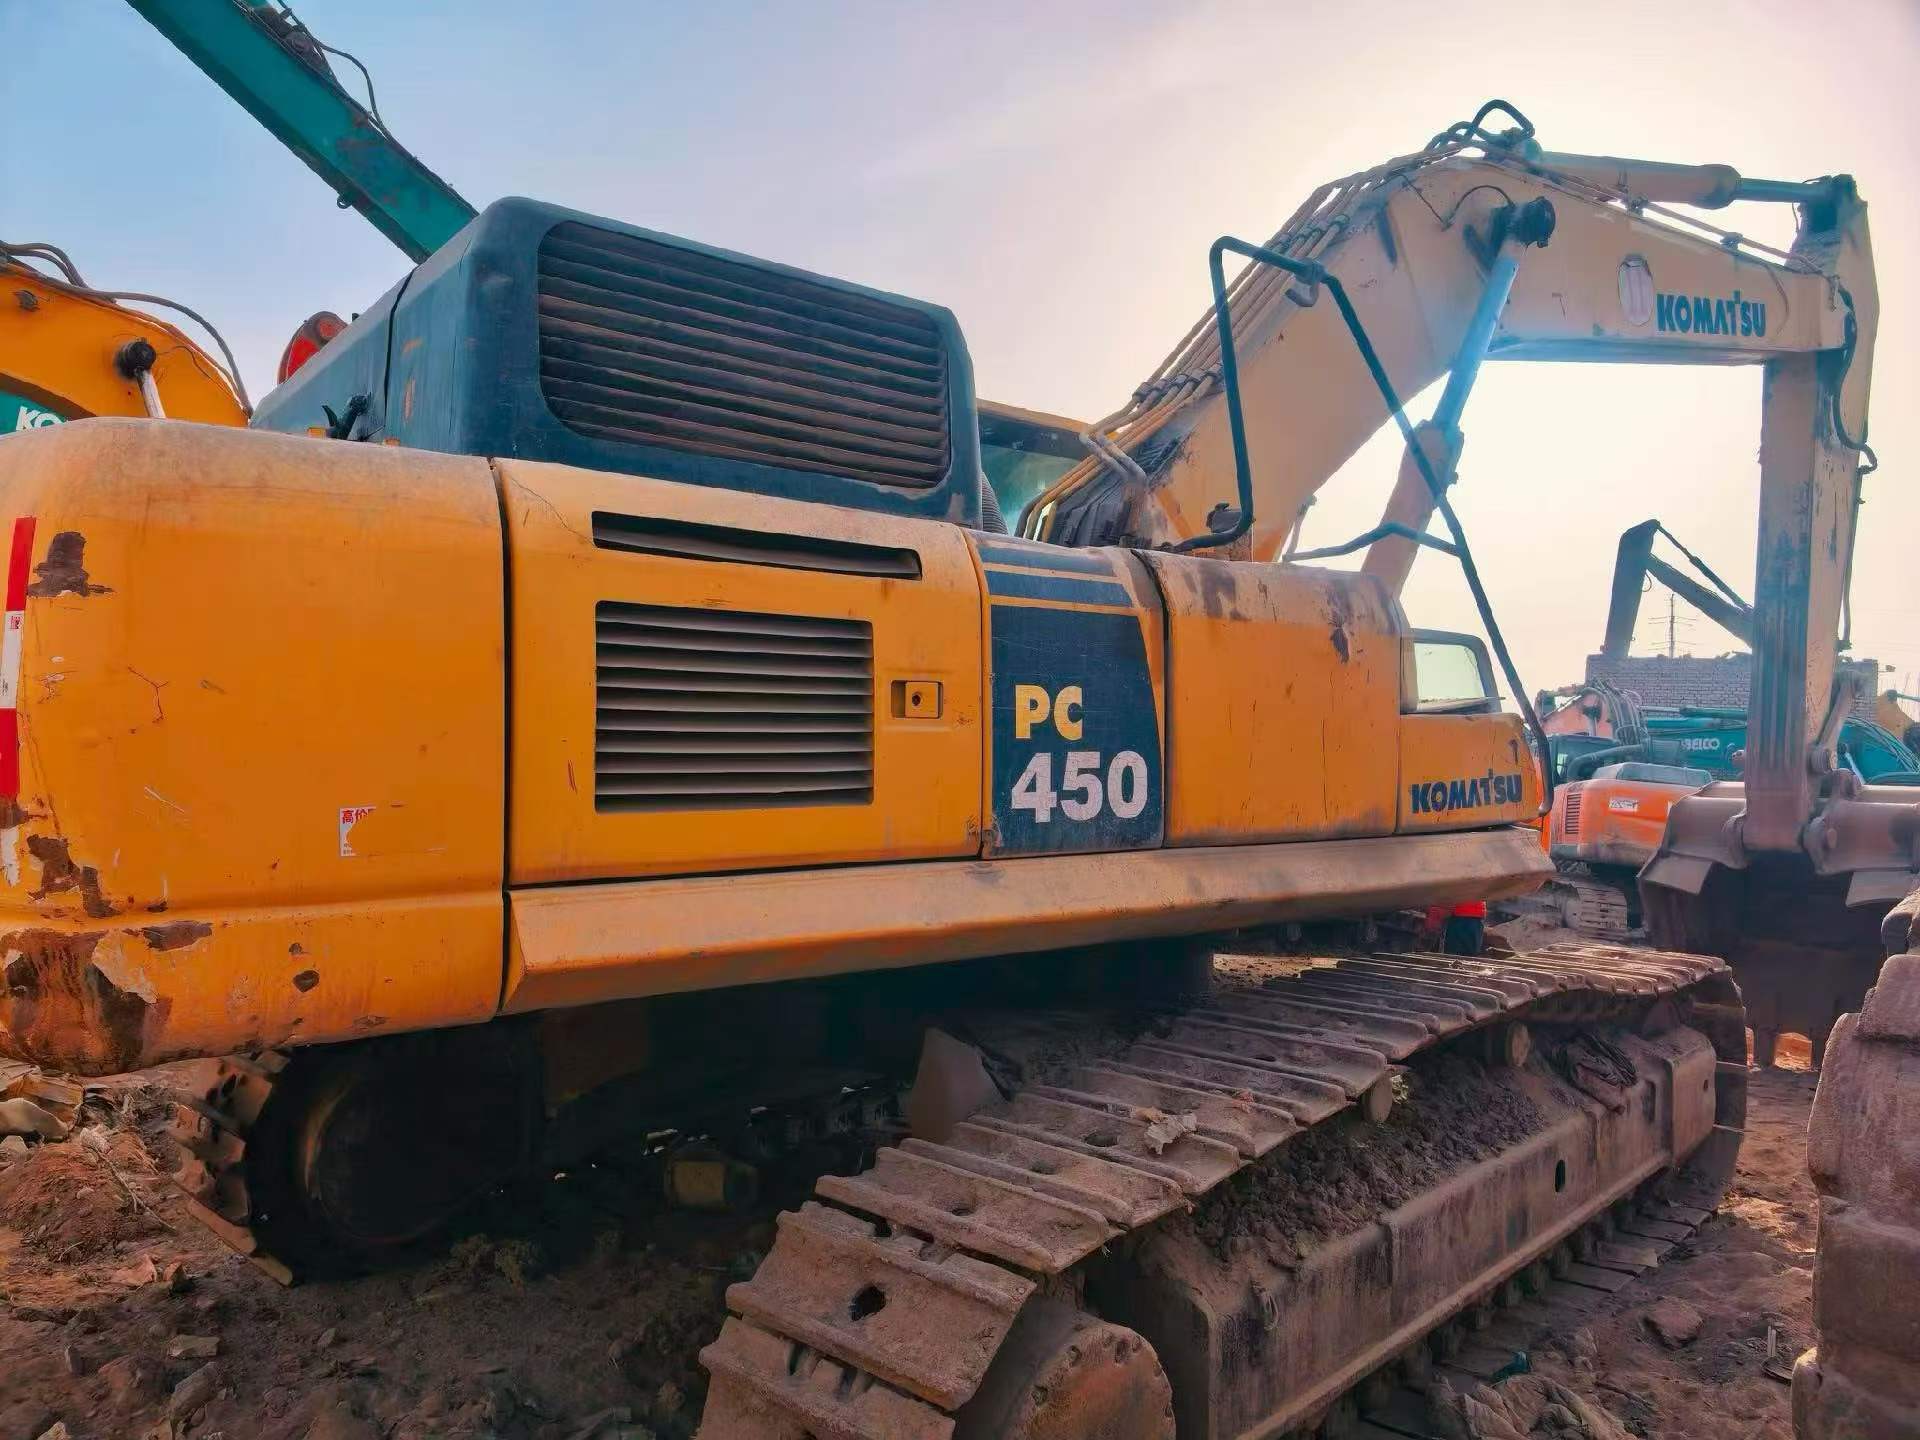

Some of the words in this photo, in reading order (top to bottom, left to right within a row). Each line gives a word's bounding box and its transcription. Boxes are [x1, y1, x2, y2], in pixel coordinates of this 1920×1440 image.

[1656, 291, 1766, 337] KOMATSU
[1016, 684, 1083, 741] PC
[1011, 750, 1148, 823] 450
[1411, 768, 1522, 813] KOMATSU
